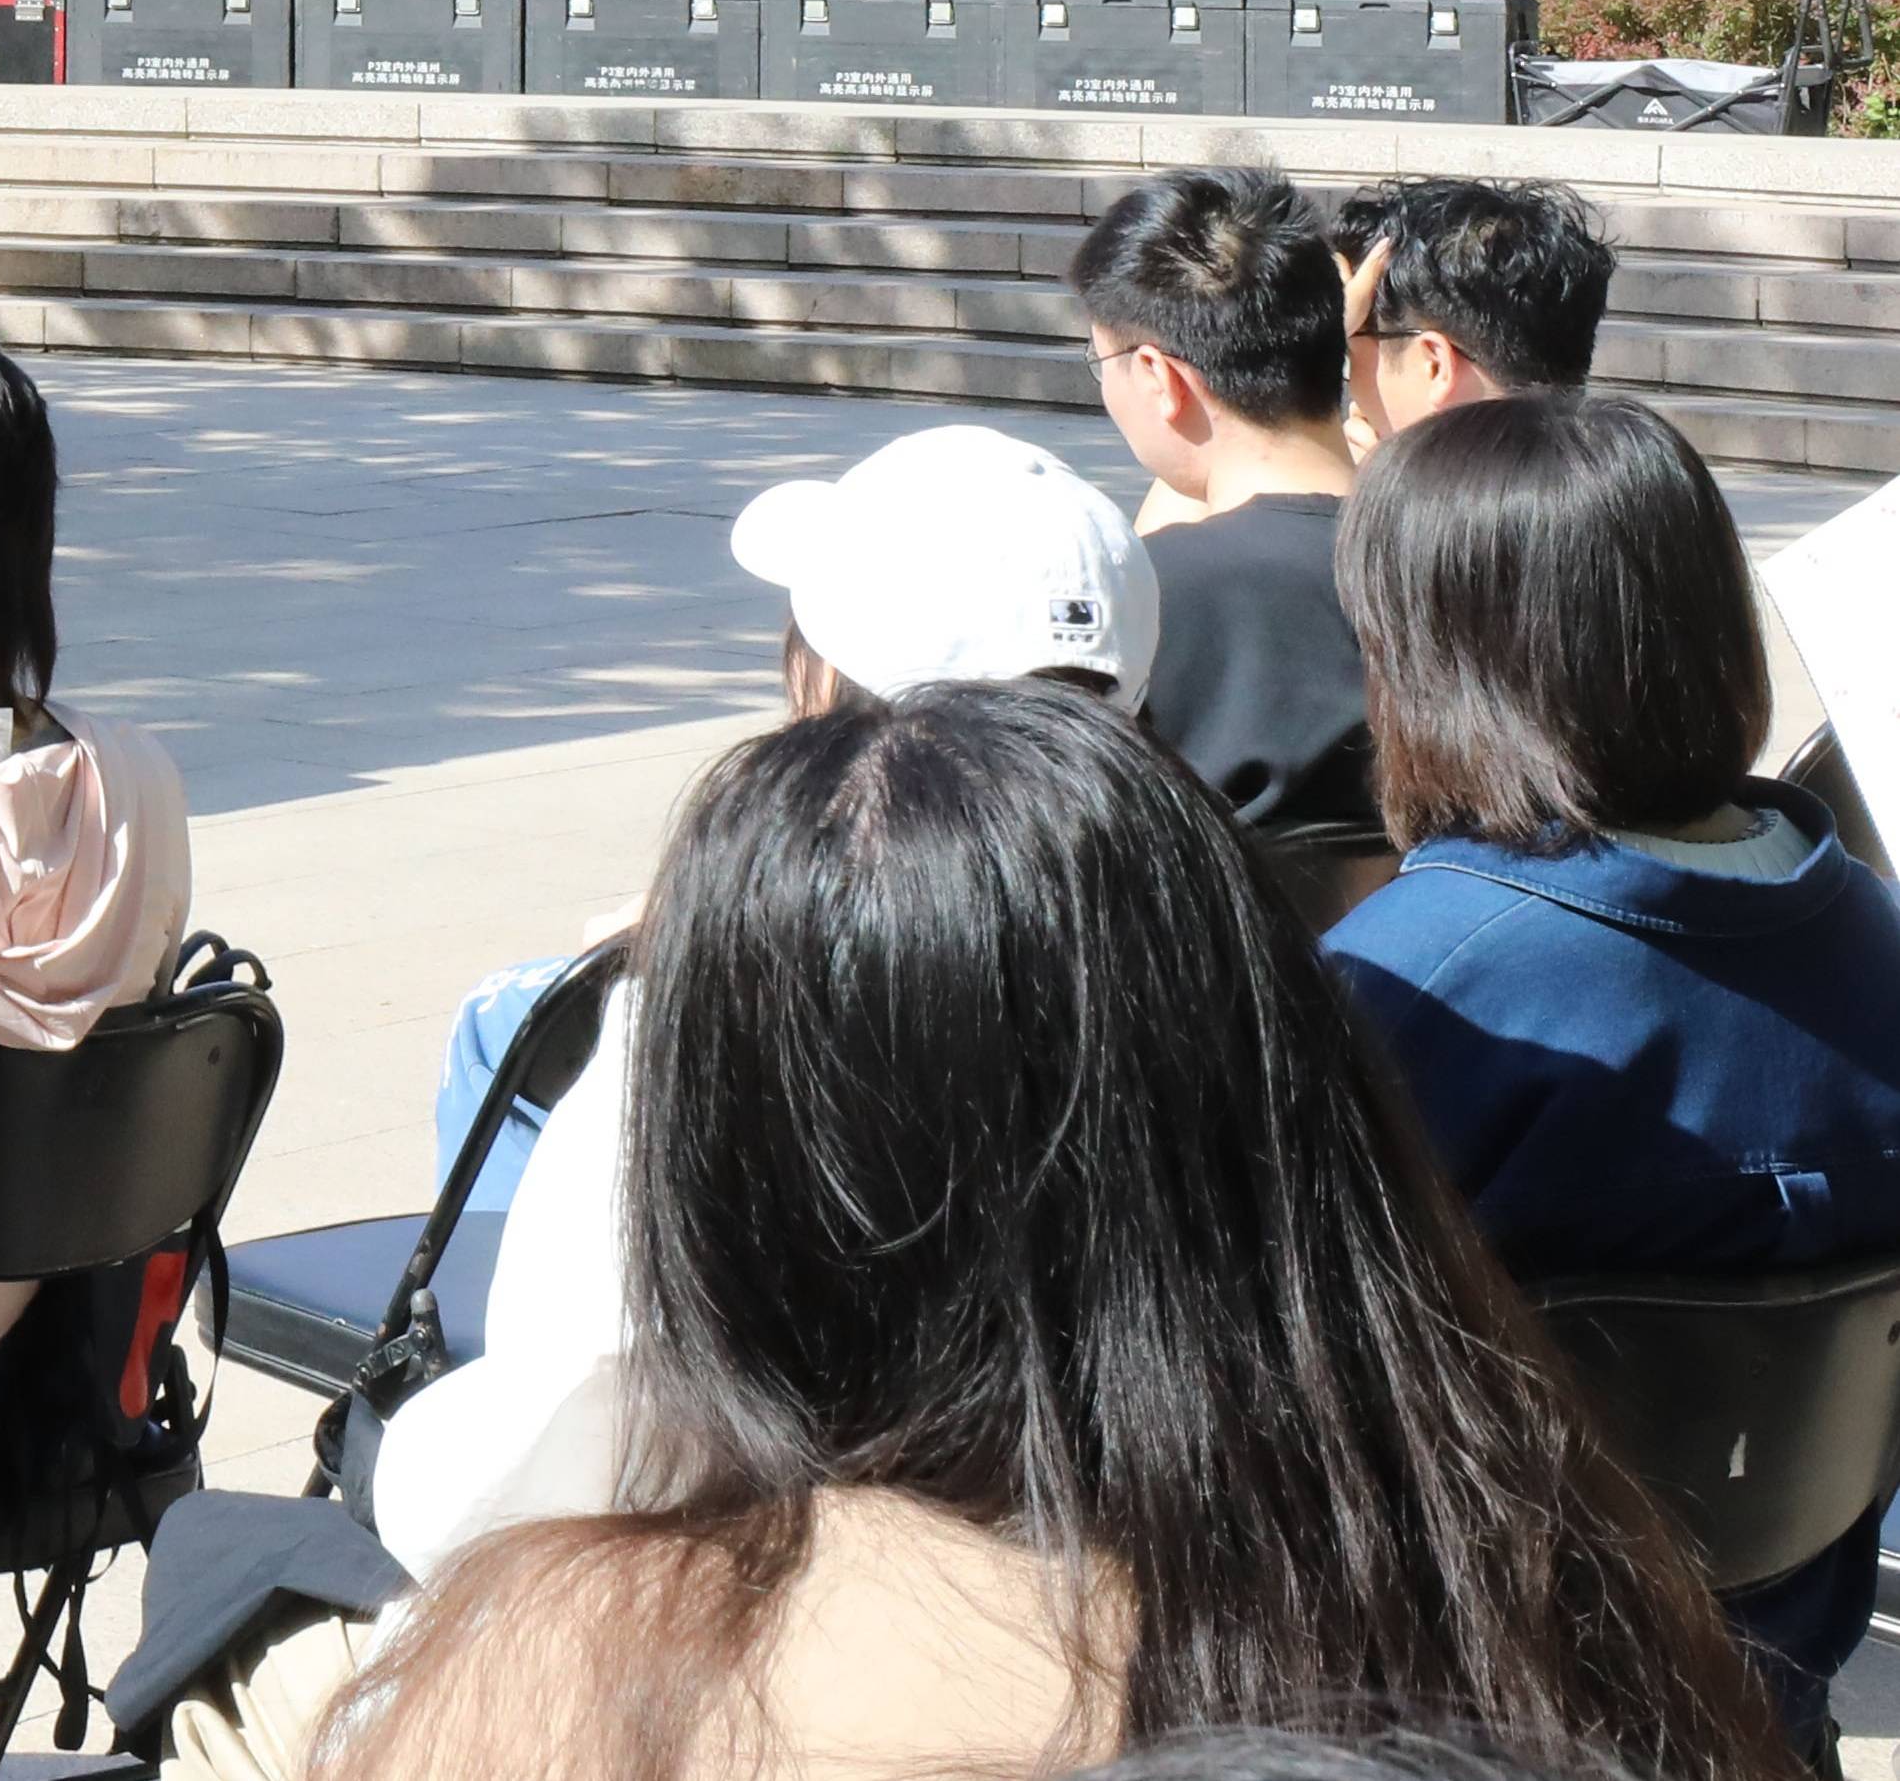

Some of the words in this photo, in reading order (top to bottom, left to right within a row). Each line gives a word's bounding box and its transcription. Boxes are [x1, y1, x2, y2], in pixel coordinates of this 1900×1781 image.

[835, 71, 912, 84] P3室内外通用
[1075, 78, 1155, 91] P3室内外通用
[1329, 84, 1413, 98] P3室内外通用
